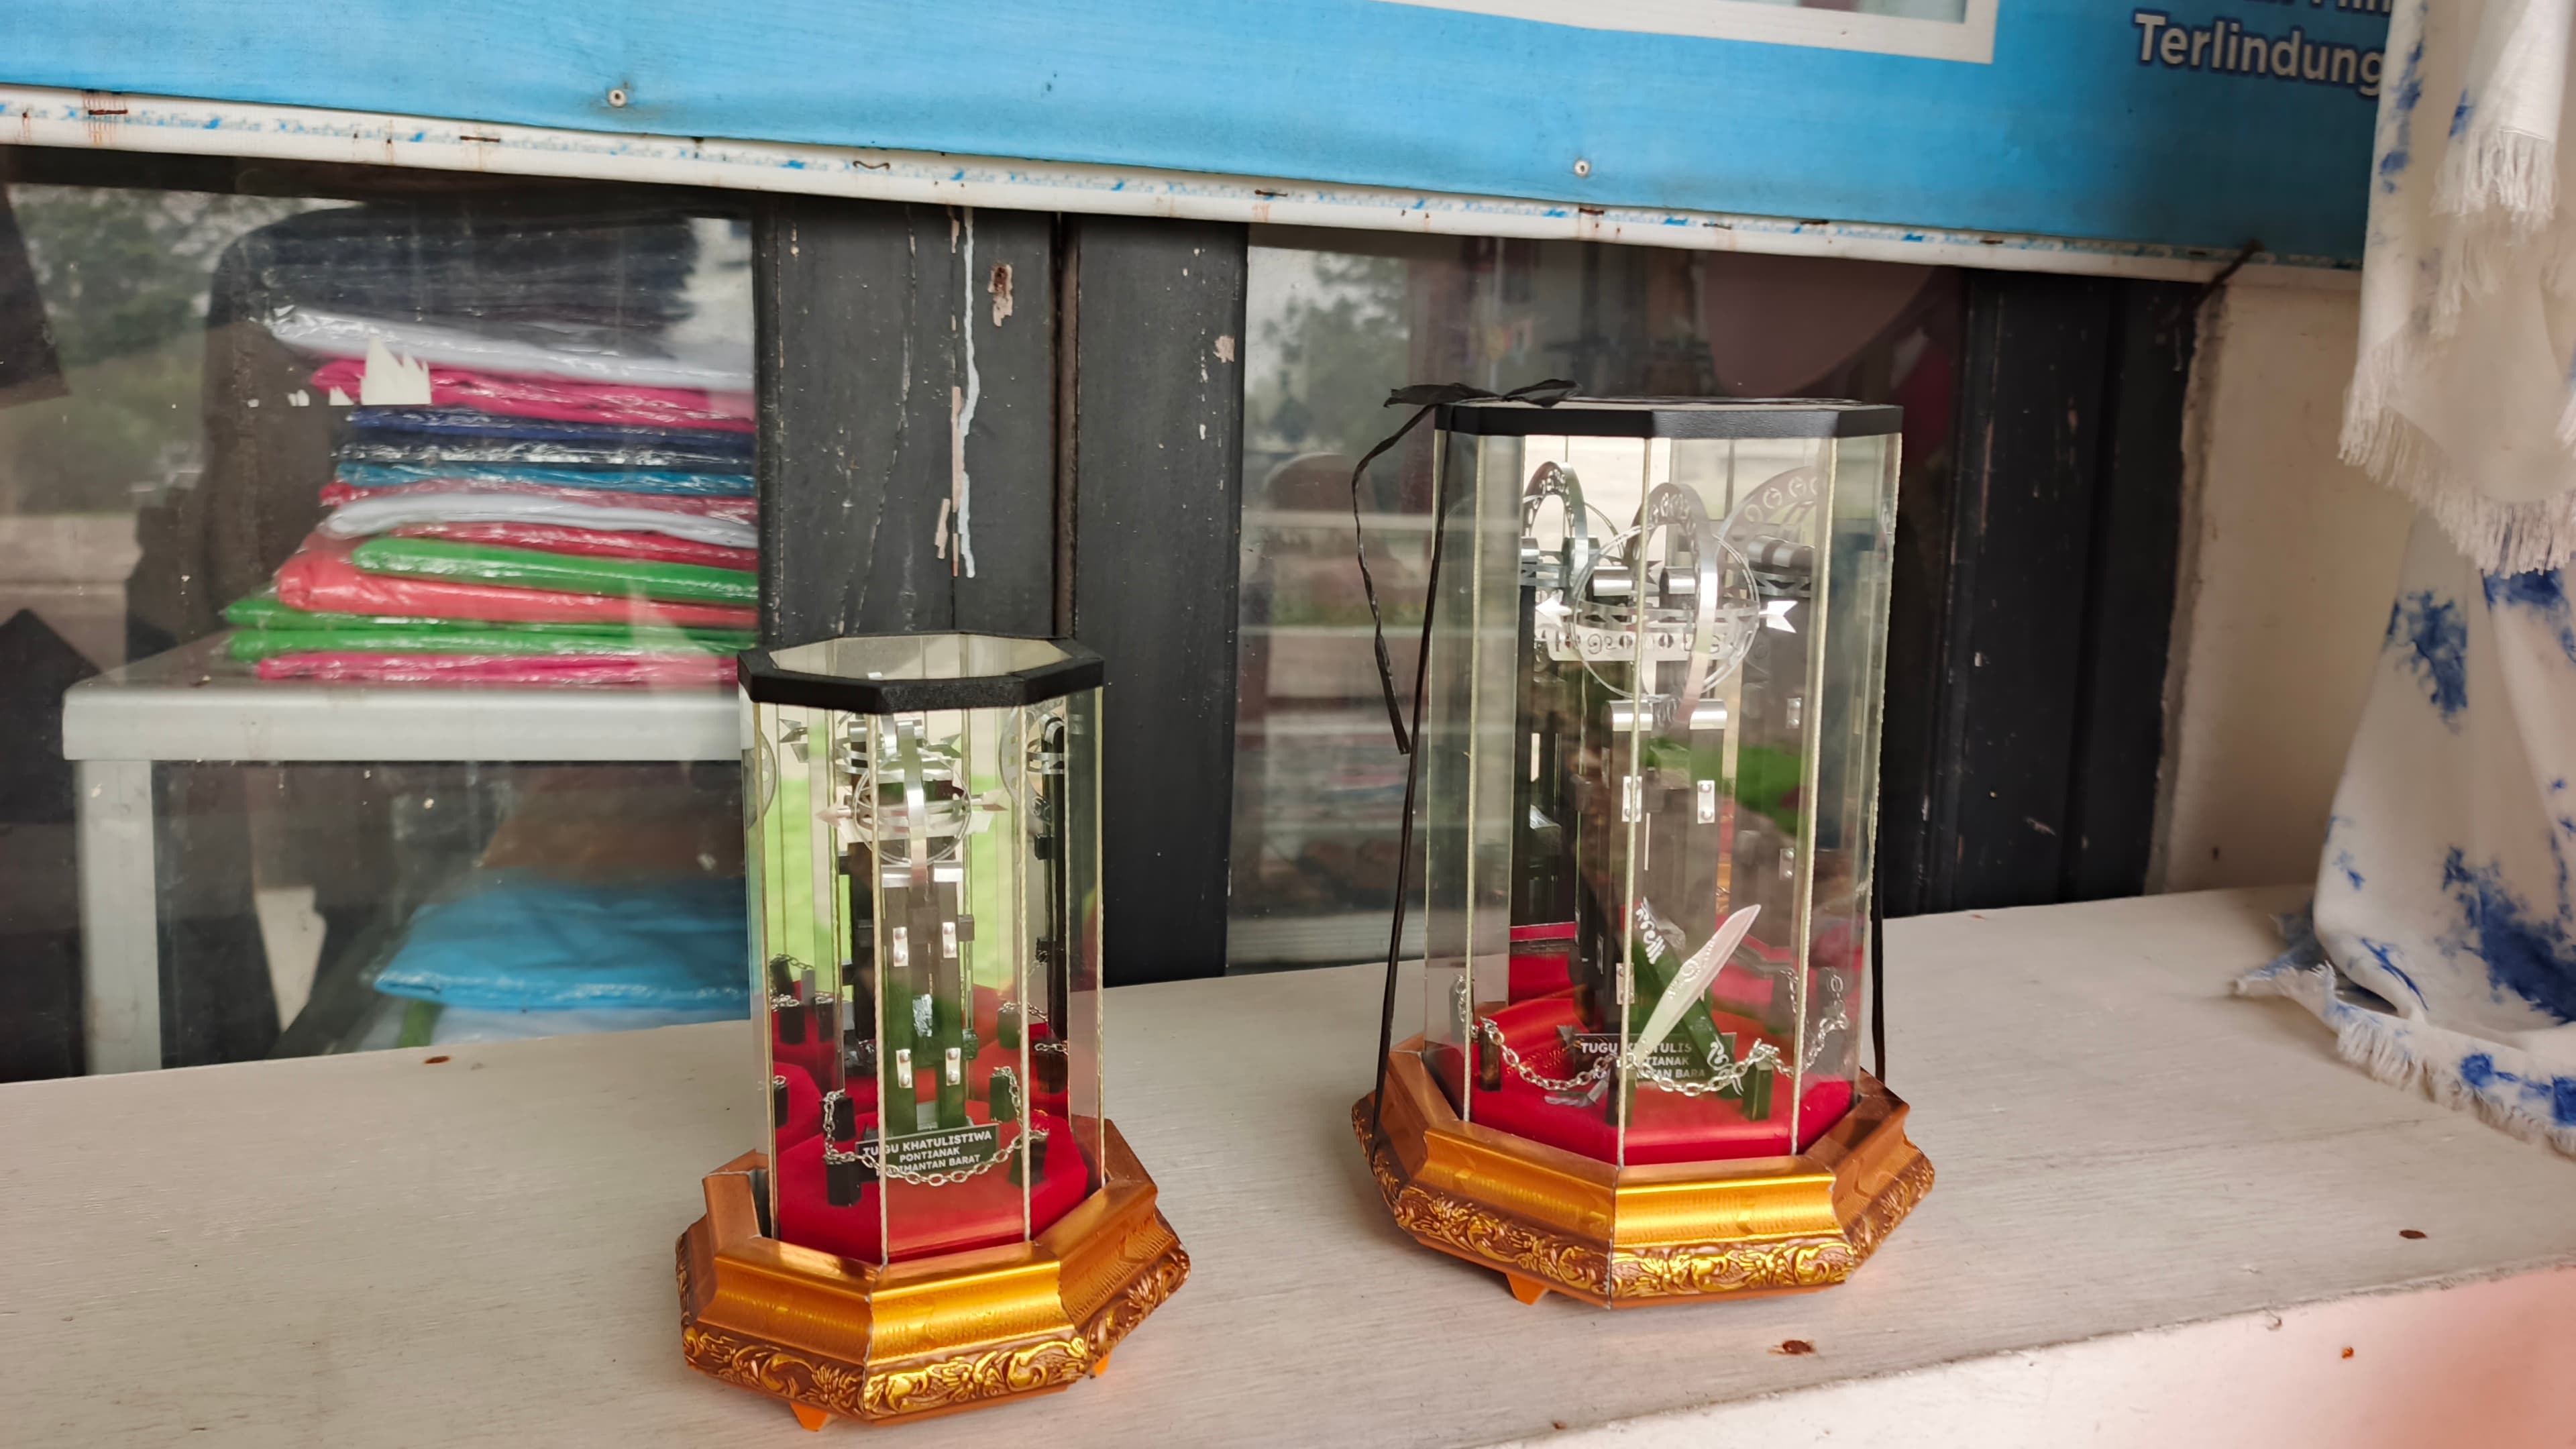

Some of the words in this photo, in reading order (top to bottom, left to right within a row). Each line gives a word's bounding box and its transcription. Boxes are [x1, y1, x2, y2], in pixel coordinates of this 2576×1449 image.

[1580, 1042, 1618, 1054] TUGU
[1675, 1068, 1706, 1079] BARA
[902, 1130, 993, 1152] KHATULISTIWA
[899, 1146, 961, 1163] PONTIANAK
[948, 1154, 981, 1167] BARAT
